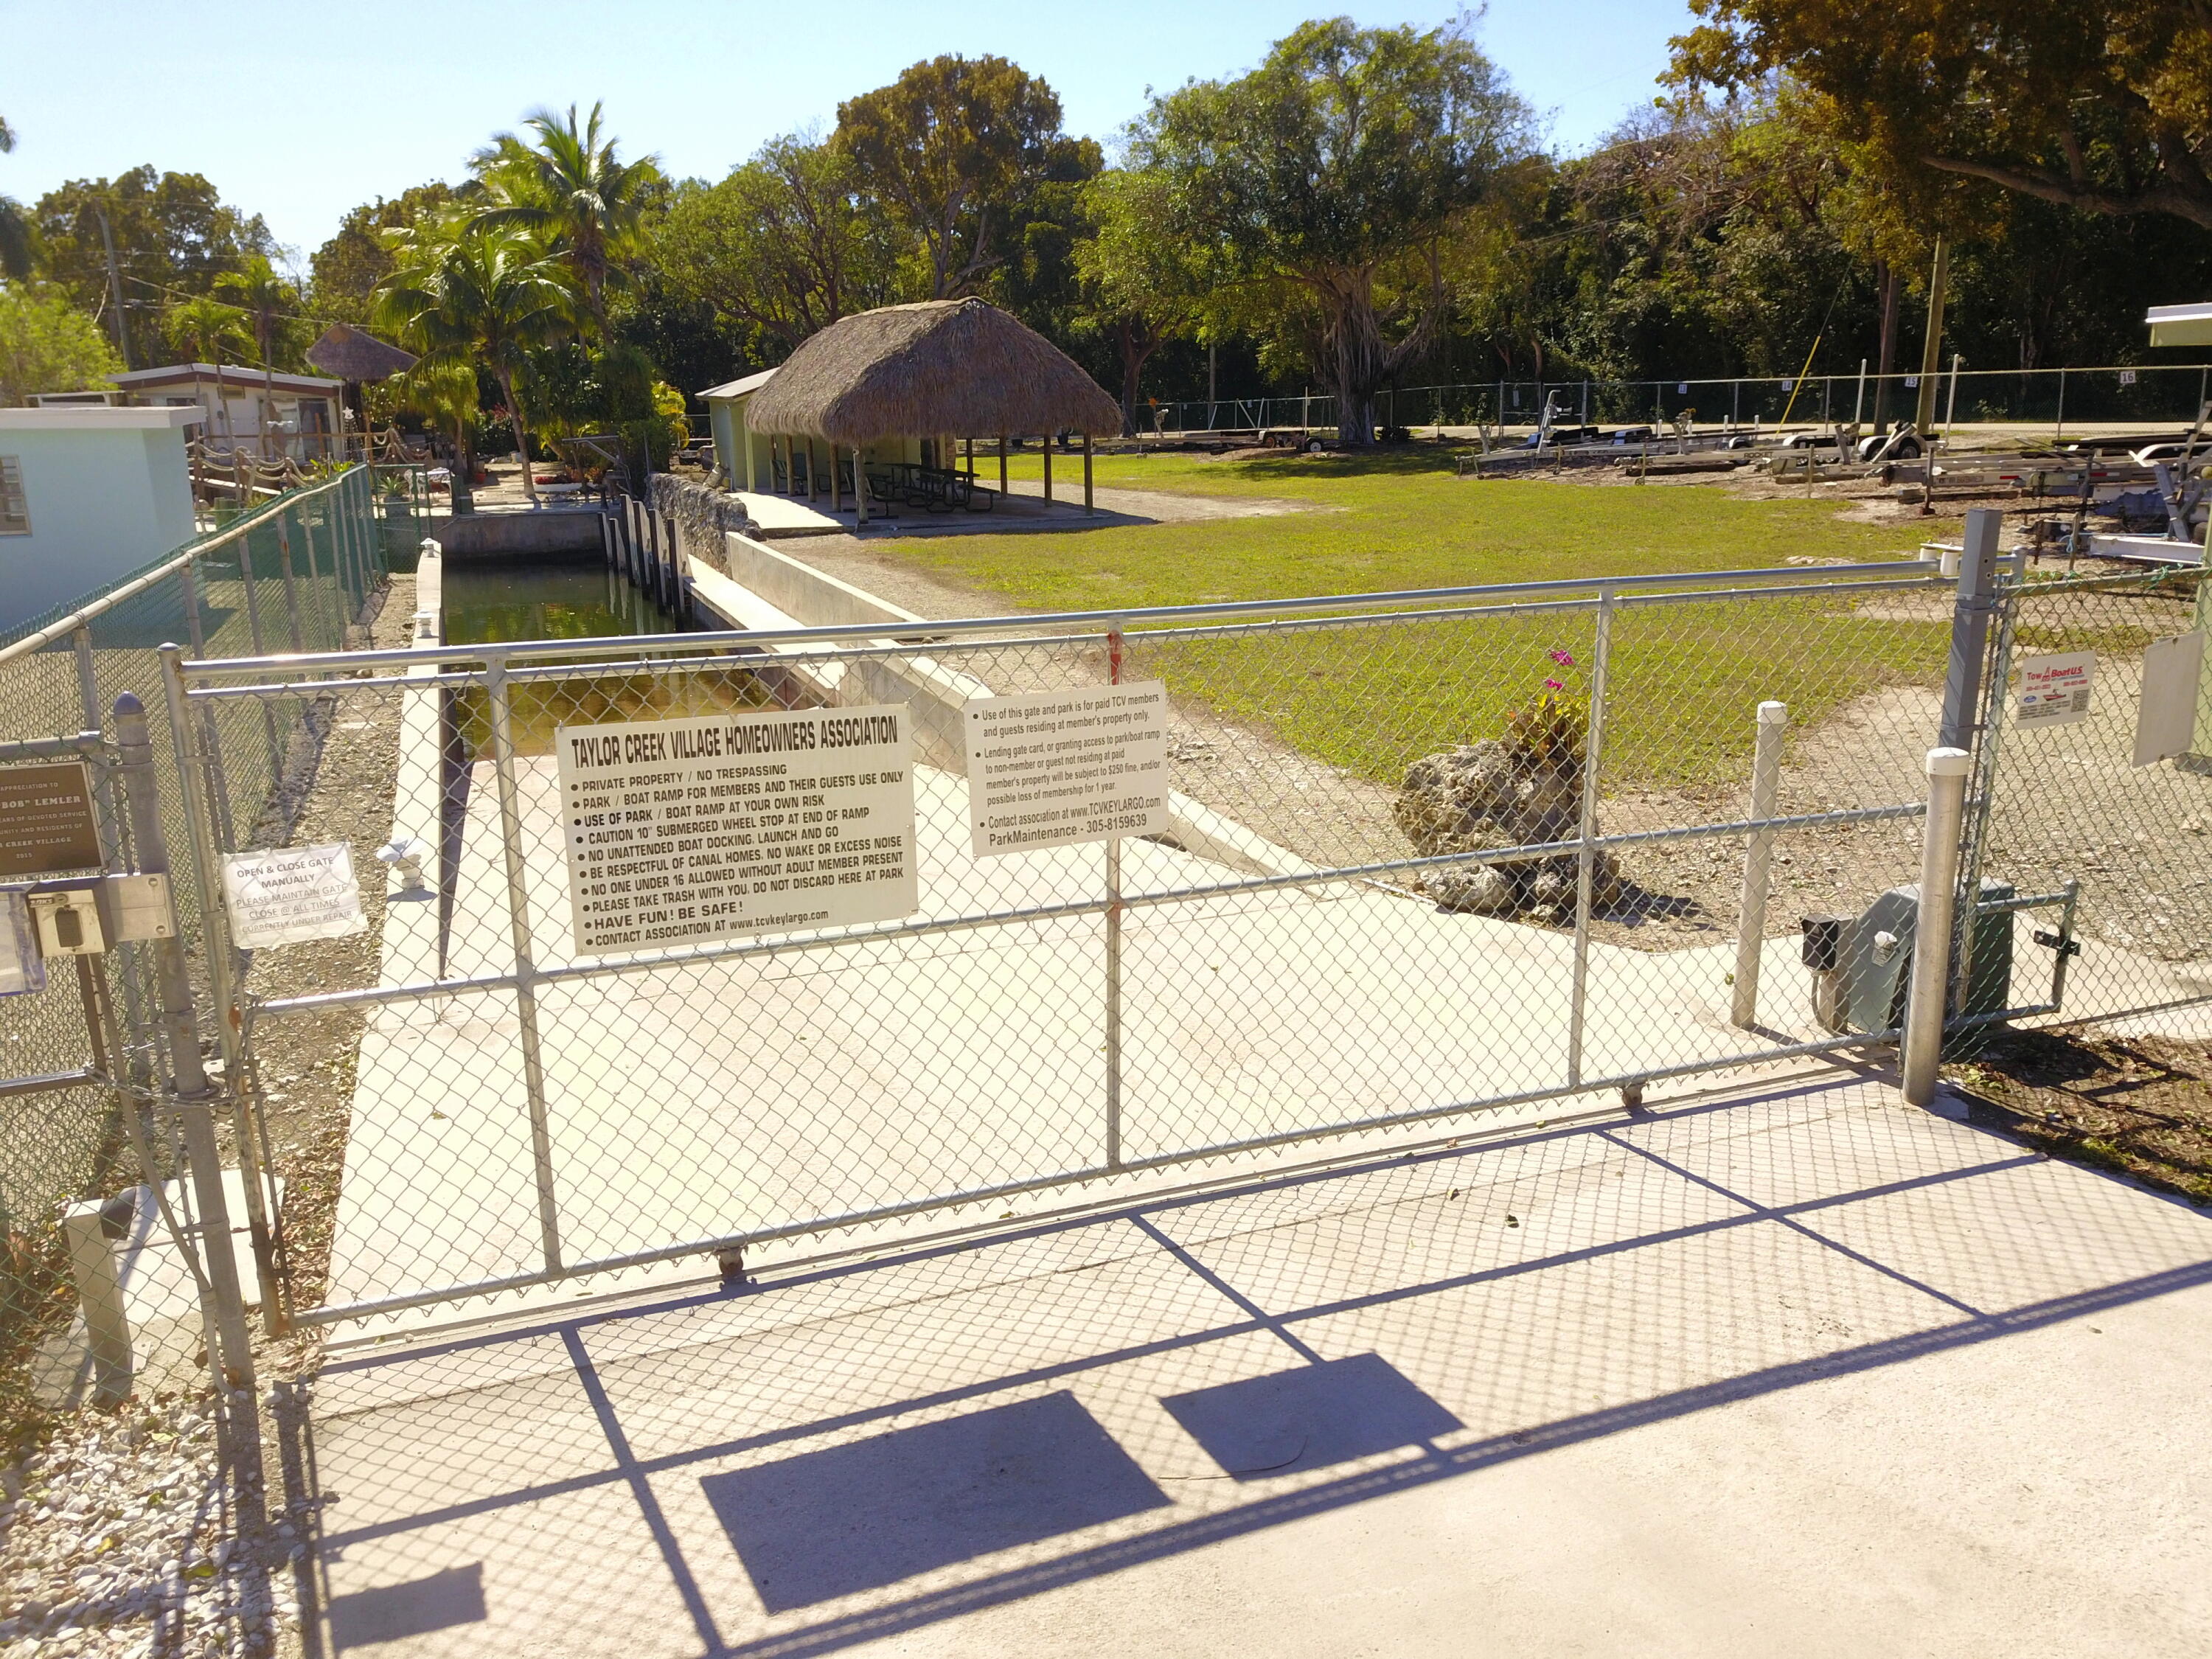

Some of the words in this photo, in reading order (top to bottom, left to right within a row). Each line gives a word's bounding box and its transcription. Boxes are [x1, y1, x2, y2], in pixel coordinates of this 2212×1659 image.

[2123, 373, 2134, 382] 16
[2027, 672, 2042, 681] Tow
[981, 709, 997, 721] Use
[998, 707, 1006, 720] of
[1008, 707, 1023, 719] this
[1024, 706, 1040, 720] gate
[1042, 703, 1056, 715] and
[1057, 701, 1074, 717] park
[1075, 700, 1082, 712] is
[1083, 700, 1093, 711] for
[1095, 697, 1110, 712] paid
[1111, 695, 1127, 708] TCV
[1127, 692, 1159, 706] members
[983, 725, 998, 737] and
[999, 723, 1025, 739] guests
[1026, 720, 1056, 734] residing
[1057, 719, 1065, 730] at
[1066, 714, 1101, 728] member's
[1102, 712, 1133, 727] property
[1133, 709, 1150, 723] only.
[571, 735, 622, 768] TAYLOR
[625, 732, 667, 764] CREEK
[669, 727, 722, 759] VILLAGE
[725, 720, 815, 756] HOMEOWNERS
[821, 715, 898, 749] ASSOCIATION
[984, 745, 1012, 759] Lending
[1012, 744, 1028, 758] gate
[1029, 742, 1046, 754] card,
[1046, 742, 1054, 752] or
[1055, 738, 1082, 754] granting
[1083, 737, 1106, 748] access
[1106, 734, 1113, 745] to
[1114, 731, 1144, 746] park/boat
[1144, 730, 1161, 741] ramp
[582, 777, 625, 792] PRIVATE
[629, 772, 684, 787] PROPERTY
[697, 770, 713, 781] NO
[716, 764, 787, 779] TRESPASSING
[986, 776, 1020, 790] member's
[1021, 773, 1051, 788] property
[1051, 771, 1063, 782] will
[1064, 771, 1074, 781] be
[1074, 767, 1099, 781] subject
[1100, 766, 1107, 776] to
[1108, 763, 1124, 776] $250
[1124, 762, 1139, 773] fine,
[1140, 759, 1161, 771] and/or
[35, 796, 81, 806] LEMLER
[582, 796, 611, 810] PARK
[624, 791, 650, 806] BOAT
[653, 788, 684, 803] RAMP
[686, 786, 707, 800] FOR
[710, 782, 761, 798] MEMBERS
[765, 780, 786, 793] AND
[788, 778, 816, 791] THEIR
[819, 774, 856, 789] GUESTS
[859, 773, 877, 786] USE
[880, 771, 903, 784] ONLY
[584, 813, 605, 827] USE
[608, 812, 622, 825] OF
[625, 809, 653, 824] PARK
[665, 805, 692, 819] BOAT
[695, 802, 726, 816] RAMP
[728, 801, 740, 813] AT
[743, 799, 771, 812] YOUR
[774, 796, 799, 810] OWN
[802, 794, 825, 807] RISK
[988, 813, 1018, 830] Contact
[1018, 808, 1060, 826] association
[1062, 807, 1069, 820] at
[1070, 796, 1161, 818] www.TCVKEYLARGO.com
[588, 828, 633, 845] CAUTION
[656, 820, 719, 838] SUBMERGED
[721, 816, 757, 831] WHEEL
[759, 814, 785, 827] STOP
[787, 813, 799, 825] AT
[802, 811, 823, 824] END
[826, 809, 838, 821] OF
[841, 807, 869, 820] RAMP
[989, 825, 1077, 846] ParkMaintenance
[1086, 813, 1147, 834] 305-8159639
[588, 849, 604, 862] NO
[607, 841, 674, 860] UNATTENDED
[678, 838, 703, 852] BOAT
[757, 829, 798, 844] LAUNCH
[801, 827, 822, 840] AND
[825, 826, 839, 838] GO
[590, 866, 604, 880] BE
[607, 859, 669, 877] RESPECTFUL
[672, 856, 685, 869] OF
[688, 853, 723, 868] CANAL
[725, 849, 764, 863] HOMES.
[767, 847, 782, 860] NO
[785, 844, 815, 858] WAKE
[818, 842, 831, 855] OR
[834, 838, 871, 853] EXCESS
[874, 835, 902, 849] NOISE
[237, 868, 263, 878] OPEN
[277, 861, 305, 872] CLOSE
[309, 857, 333, 866] GATE
[262, 874, 315, 888] MANUALLY
[591, 883, 607, 897] NO
[610, 880, 632, 894] ONE
[635, 875, 669, 891] UNDER
[672, 874, 684, 886] 16
[688, 868, 735, 885] ALLOWED
[738, 863, 782, 879] WITHOUT
[786, 860, 815, 874] ADULT
[818, 855, 860, 871] MEMBER
[862, 851, 903, 866] PRESENT
[237, 895, 269, 907] PLEASE
[271, 888, 319, 902] MAINTAIN
[322, 884, 347, 894] GATE
[592, 897, 630, 913] PLEASE
[633, 894, 659, 908] TAKE
[661, 889, 695, 904] TRASH
[698, 886, 724, 900] WITH
[753, 881, 767, 894] DO
[770, 878, 790, 892] NOT
[793, 874, 835, 889] DISCARD
[838, 871, 862, 885] HERE
[865, 869, 877, 882] AT
[879, 867, 904, 880] PARK
[248, 908, 277, 919] CLOSE
[293, 903, 307, 912] ALL
[312, 899, 340, 910] TIMES
[594, 914, 633, 931] HAVE
[678, 906, 696, 920] BE
[595, 930, 641, 947] CONTACT
[645, 921, 711, 941] ASSOCIATION
[714, 919, 726, 932] AT
[729, 911, 829, 930] www.tcvkeylargo.com
